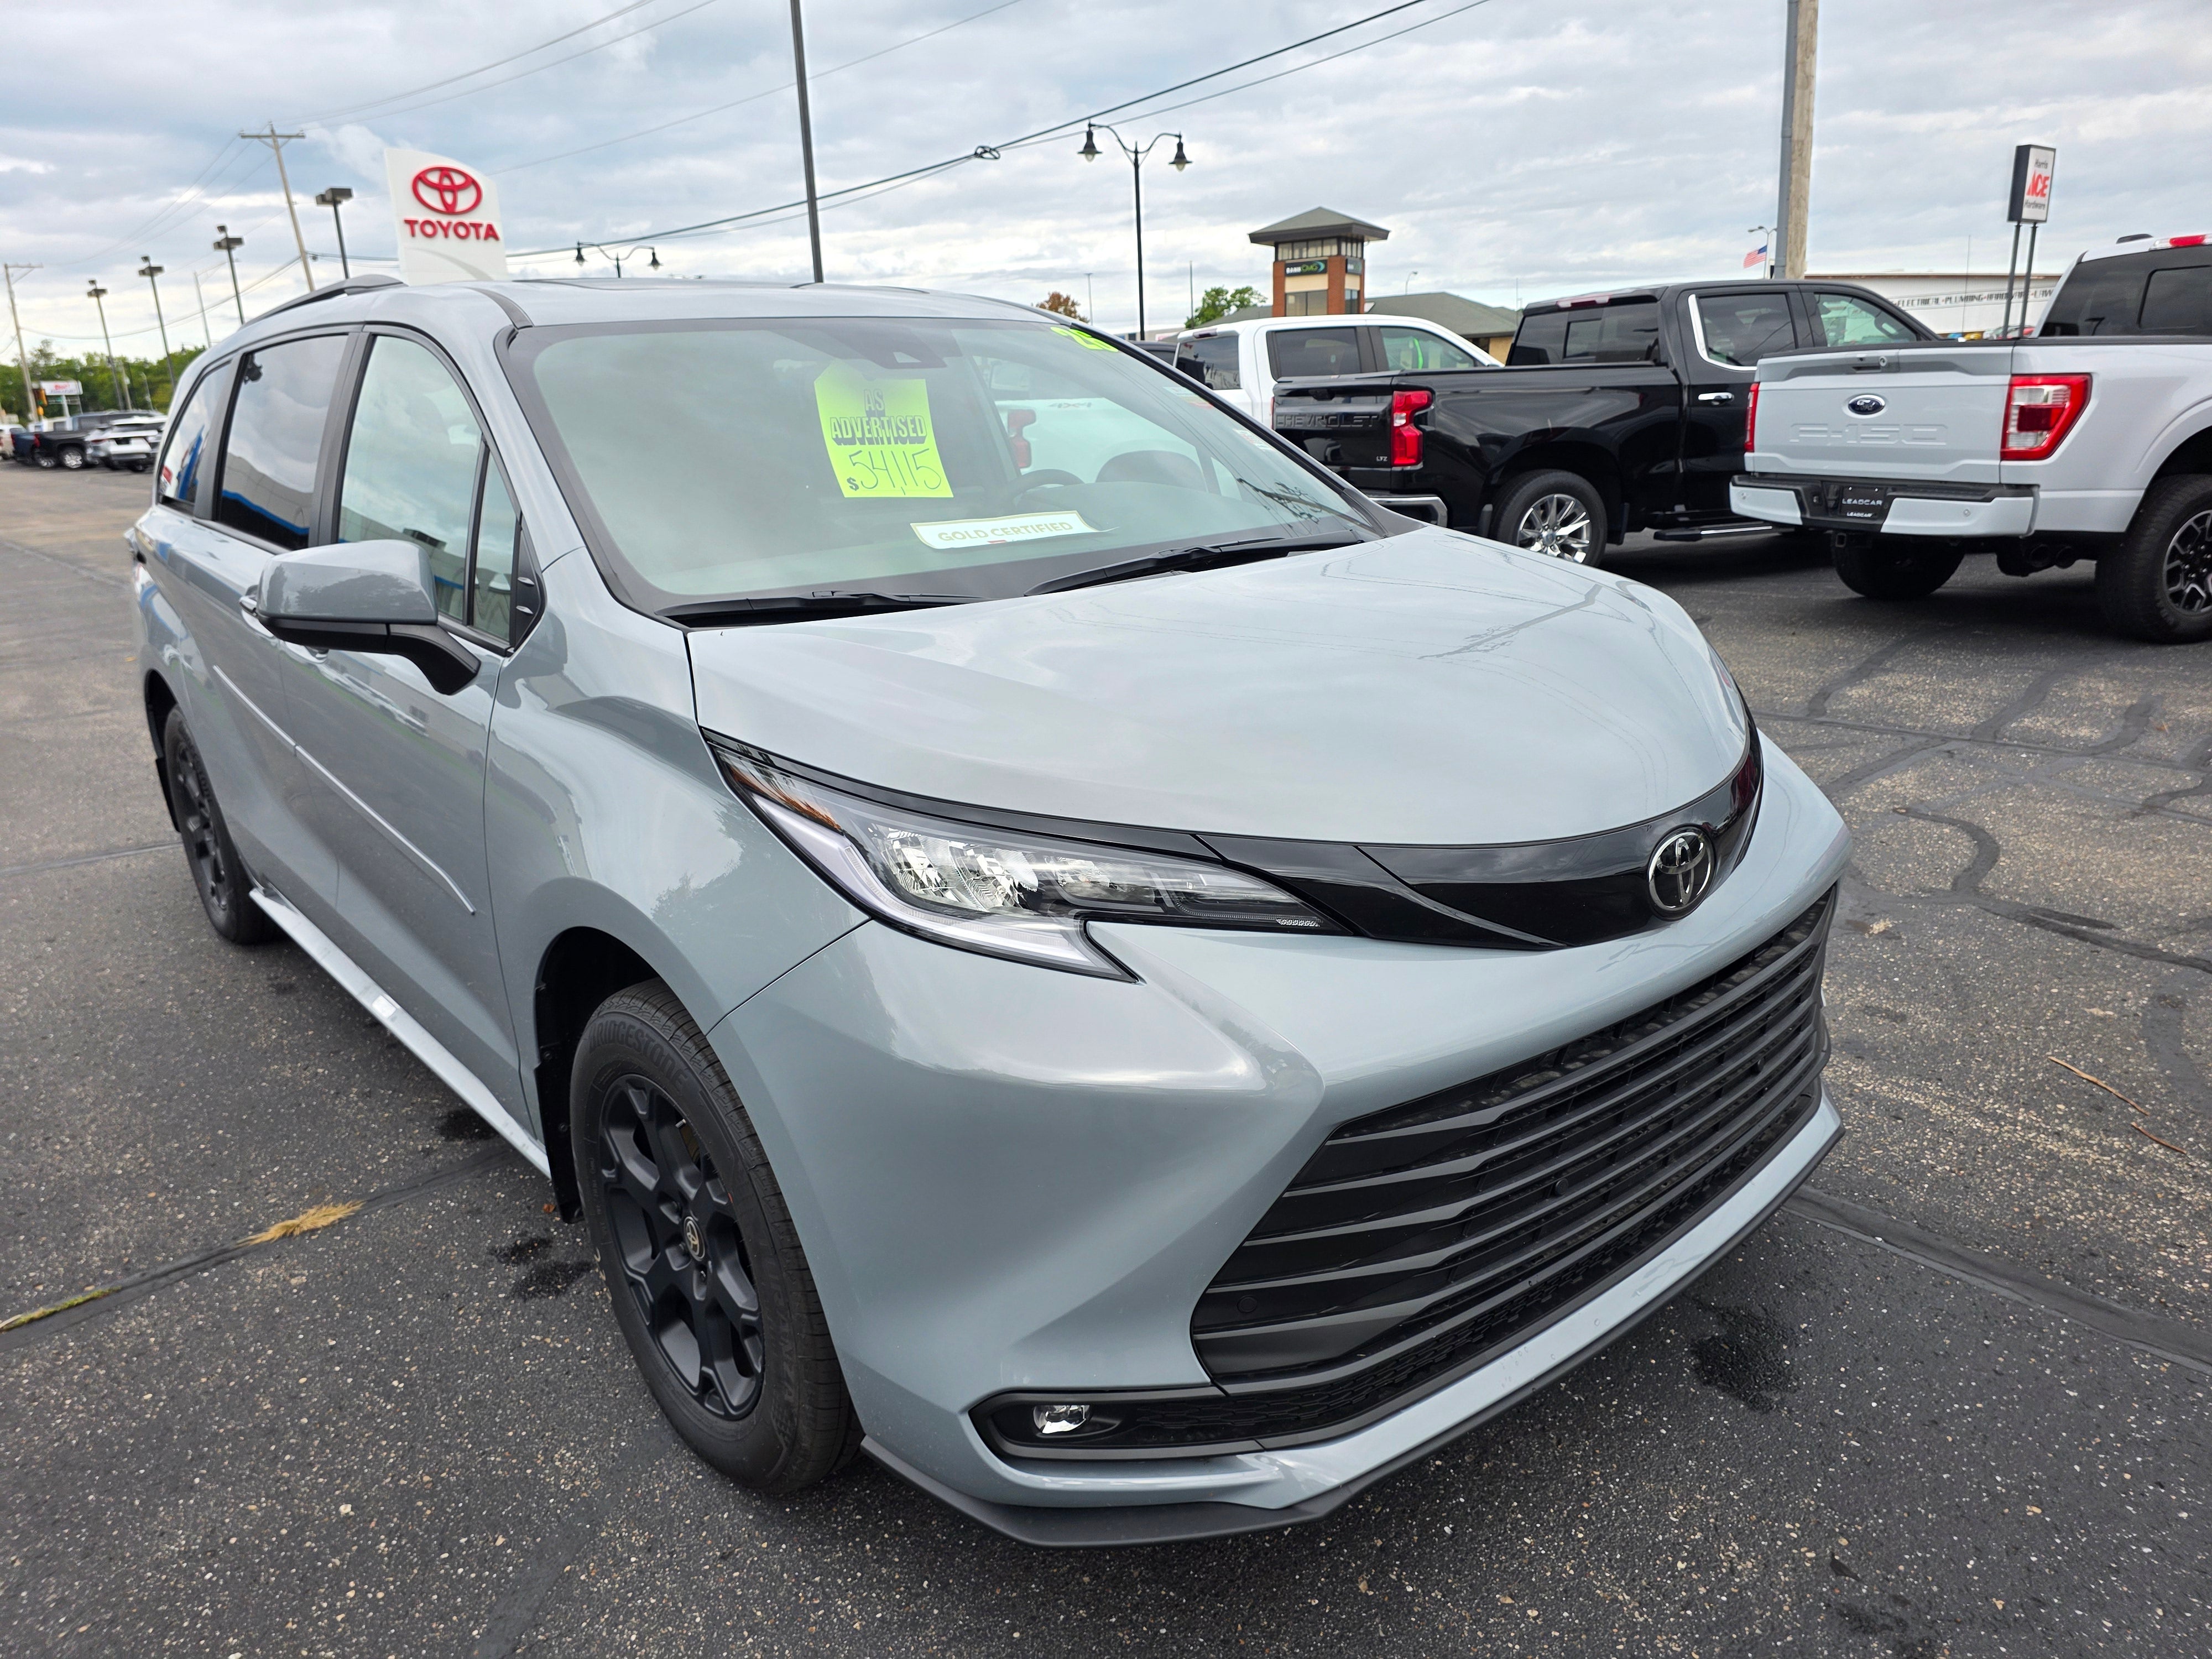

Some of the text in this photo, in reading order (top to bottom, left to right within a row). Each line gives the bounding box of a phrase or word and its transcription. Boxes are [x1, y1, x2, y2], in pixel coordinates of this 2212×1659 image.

[2034, 159, 2048, 169] Harris
[2026, 170, 2050, 198] ACE
[404, 220, 500, 241] TOYOTA
[863, 389, 885, 414] AS
[830, 415, 927, 445] ADVERTISED
[1276, 415, 1379, 428] CHEVROLET
[1789, 423, 1948, 446] F-150
[937, 521, 1073, 542] GOLD CERTIFIED
